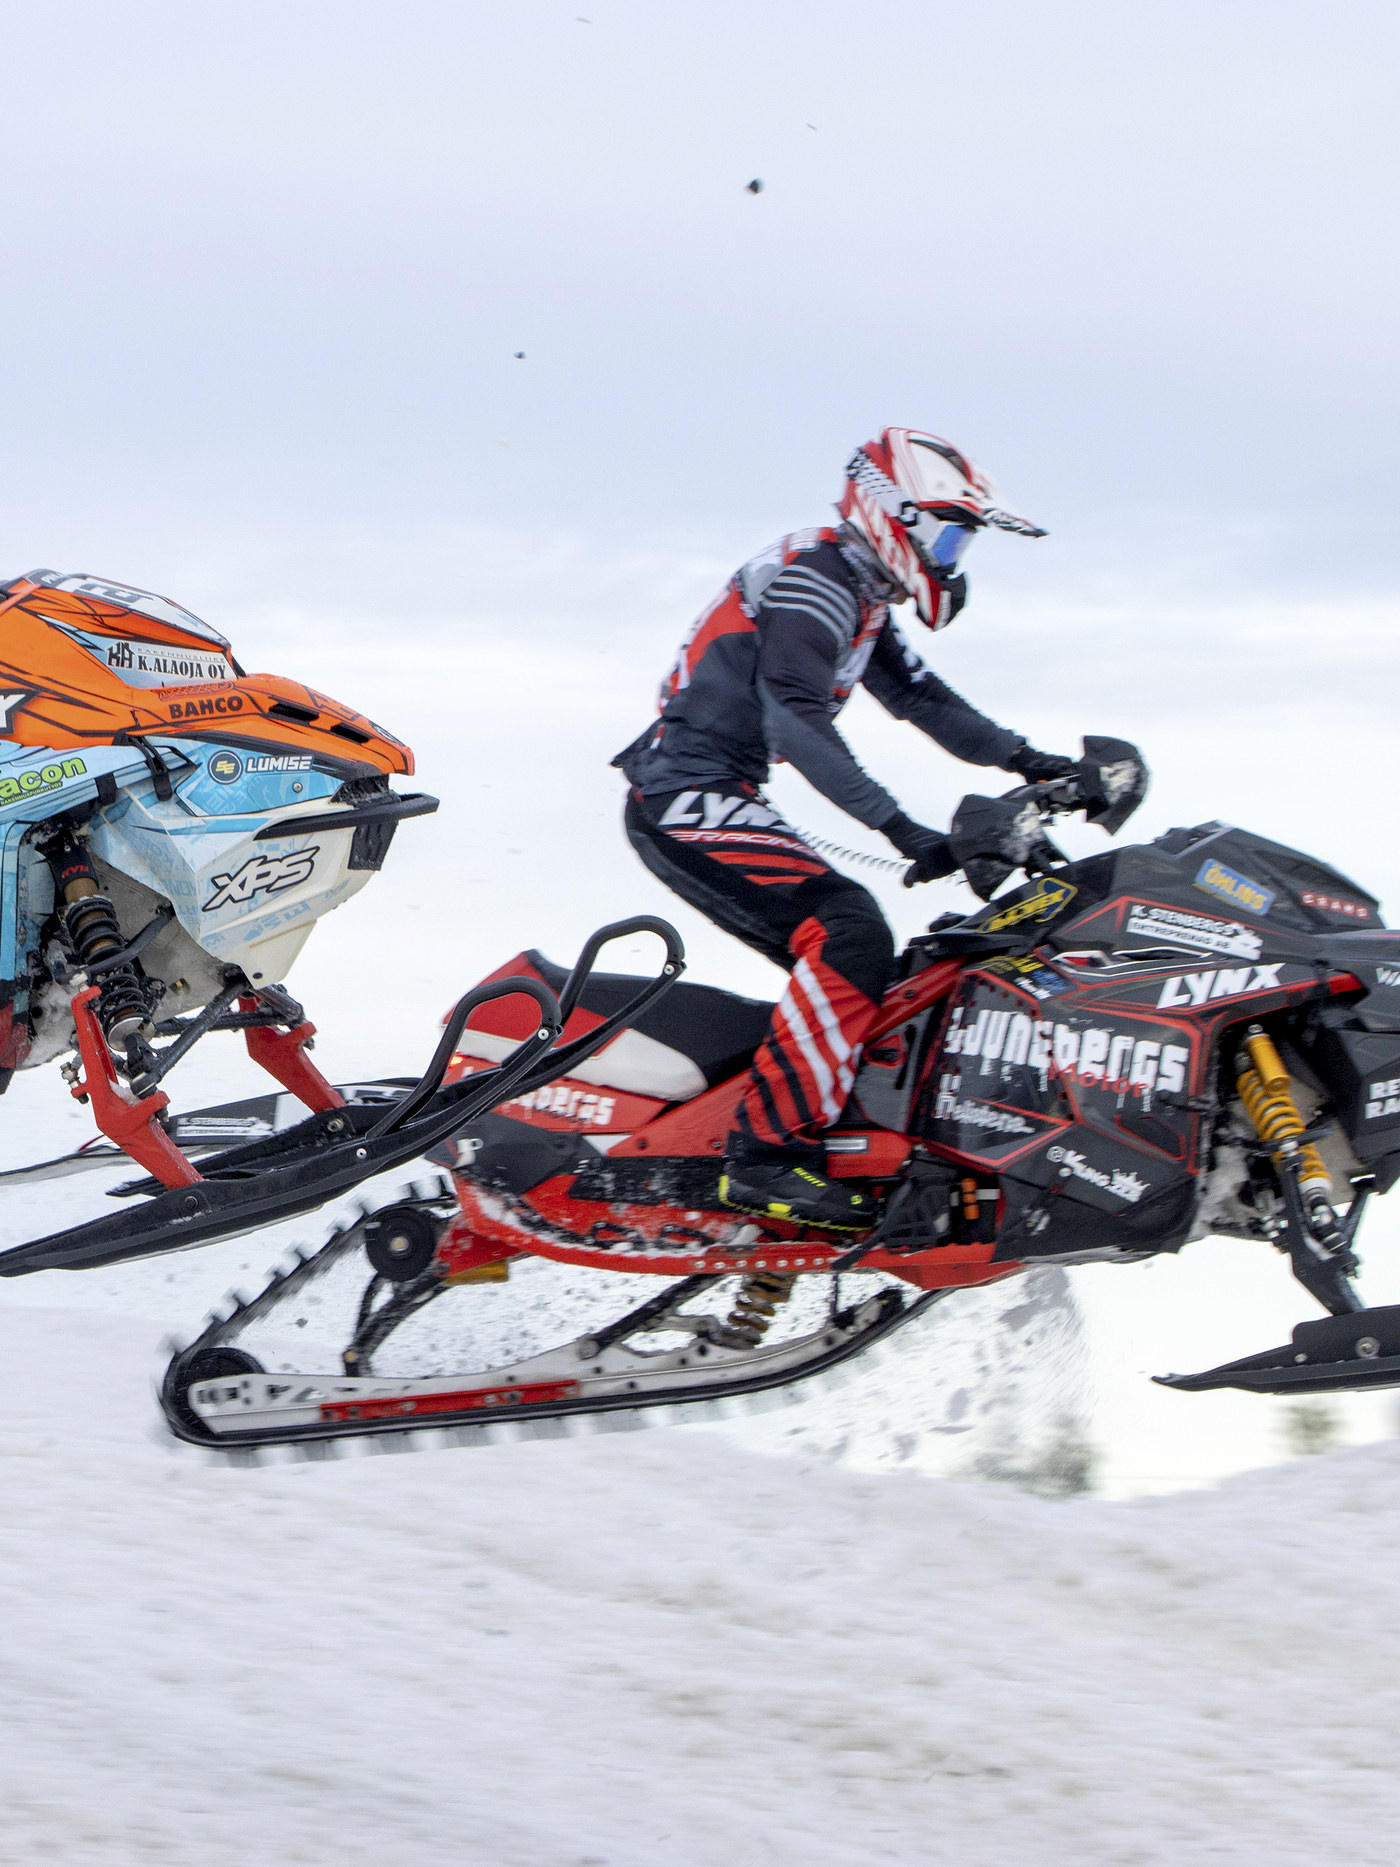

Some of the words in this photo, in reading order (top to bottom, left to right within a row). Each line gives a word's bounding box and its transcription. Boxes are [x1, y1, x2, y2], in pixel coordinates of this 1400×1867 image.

[138, 655, 204, 679] K.ALAOJA
[208, 663, 227, 680] OY
[168, 695, 244, 720] BAHCO
[246, 755, 313, 773] LUMISE
[201, 845, 320, 912] XPS
[1156, 962, 1287, 1010] LYNX
